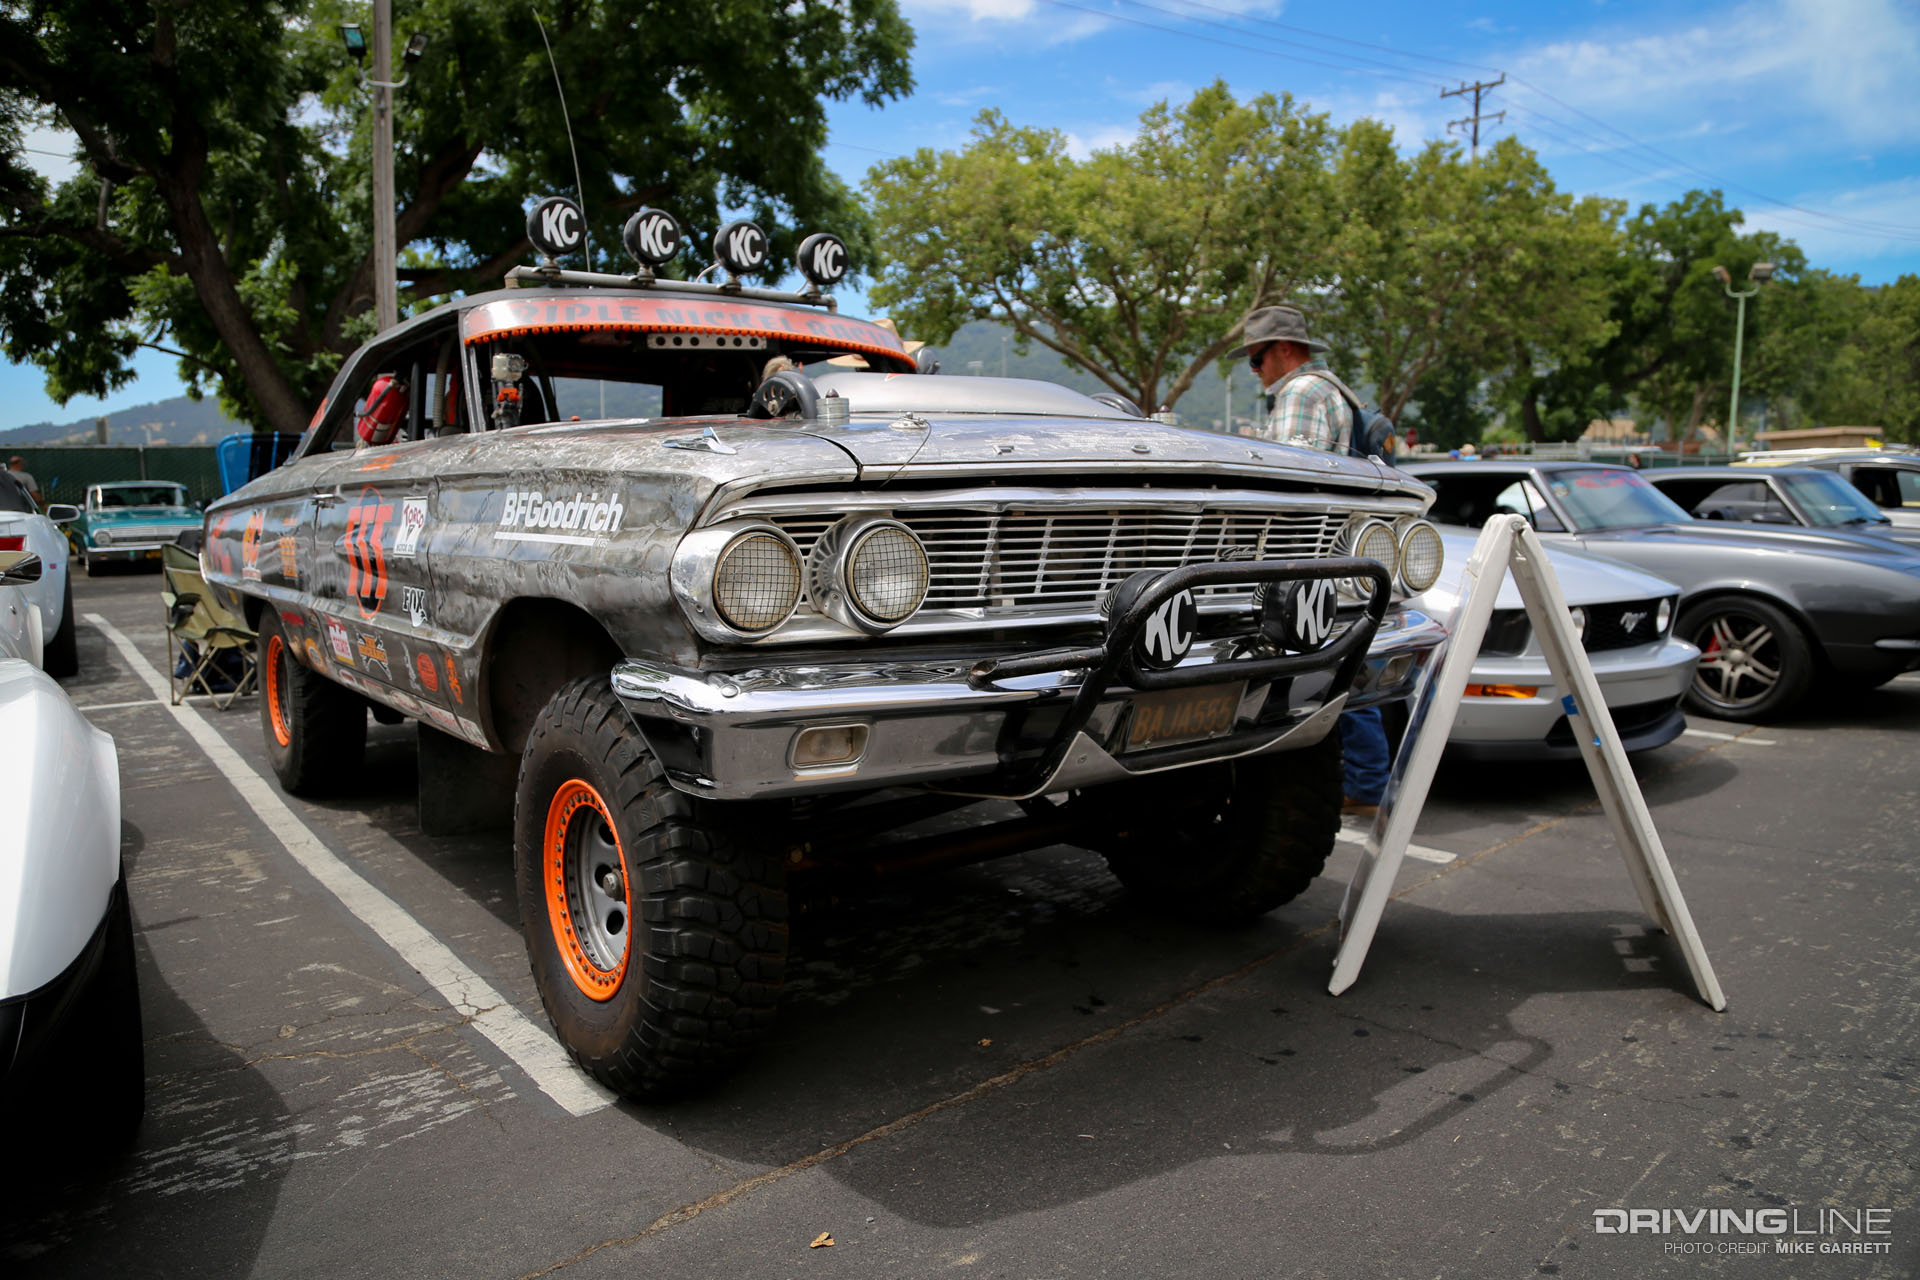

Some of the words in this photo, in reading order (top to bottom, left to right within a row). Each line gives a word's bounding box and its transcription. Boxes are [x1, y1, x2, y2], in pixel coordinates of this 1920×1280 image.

[542, 203, 580, 248] KC
[639, 215, 675, 258] KC
[729, 226, 763, 267] KC
[813, 240, 844, 280] KC
[403, 504, 425, 529] TORCO
[500, 491, 624, 532] BFGoodrich
[402, 586, 425, 614] FOX
[1296, 578, 1336, 645] KC
[1145, 588, 1193, 662] KC
